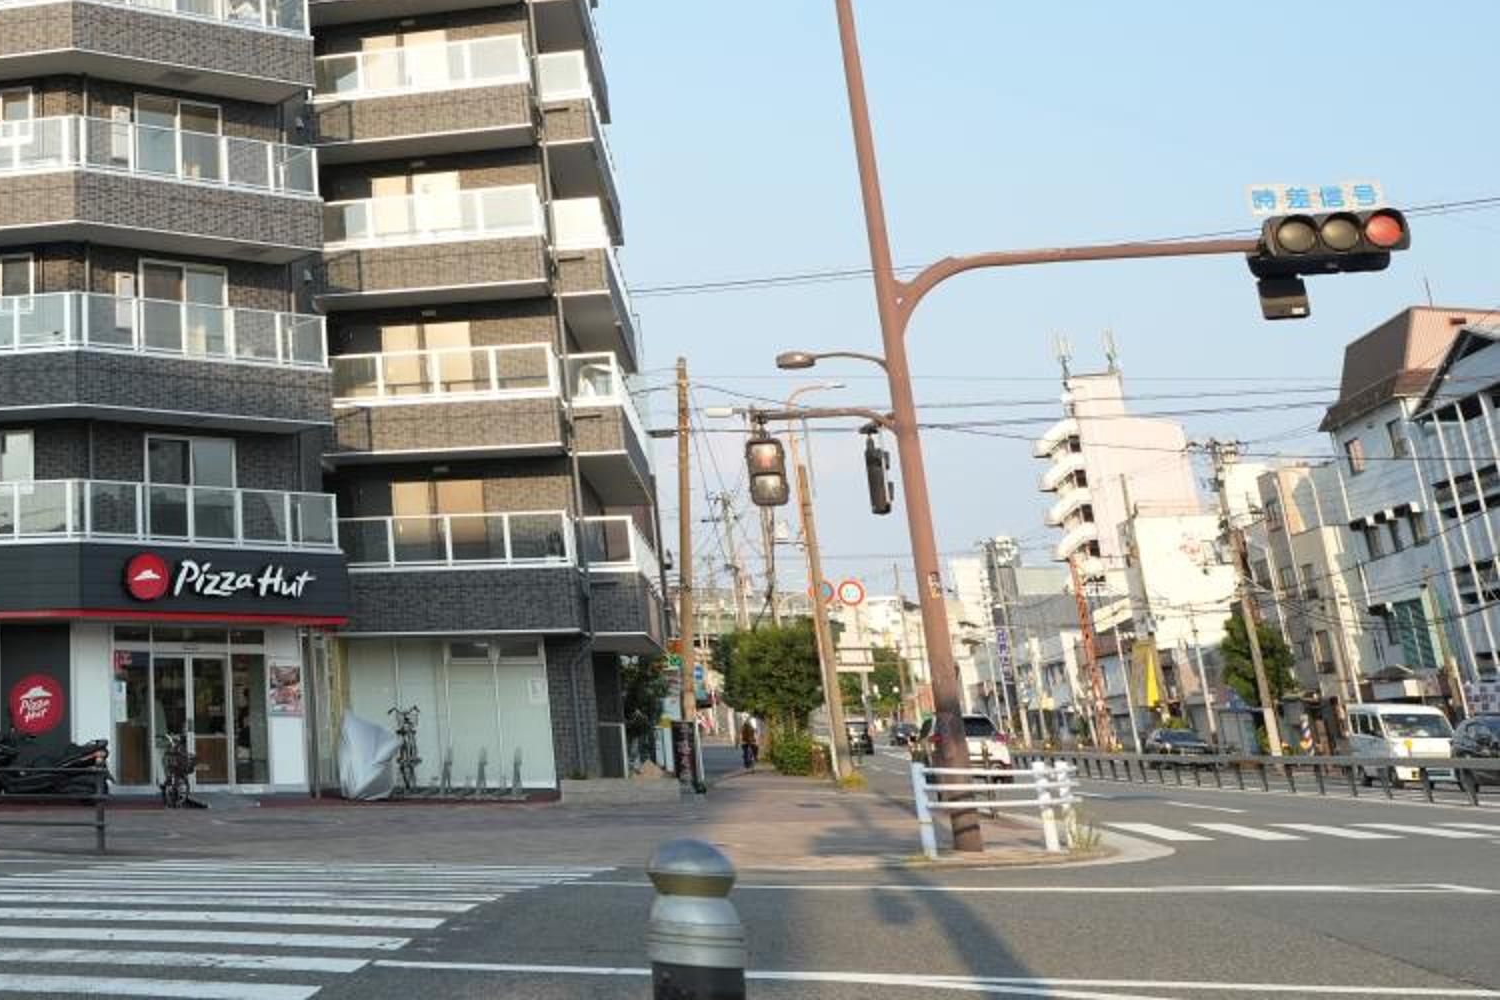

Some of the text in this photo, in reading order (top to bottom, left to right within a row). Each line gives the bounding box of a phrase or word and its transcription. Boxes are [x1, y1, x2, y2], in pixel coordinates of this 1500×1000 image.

[1250, 184, 1377, 210] 時差信号
[173, 559, 316, 598] Pizza Hut
[19, 698, 51, 715] Pizza
[24, 707, 48, 724] Hut
